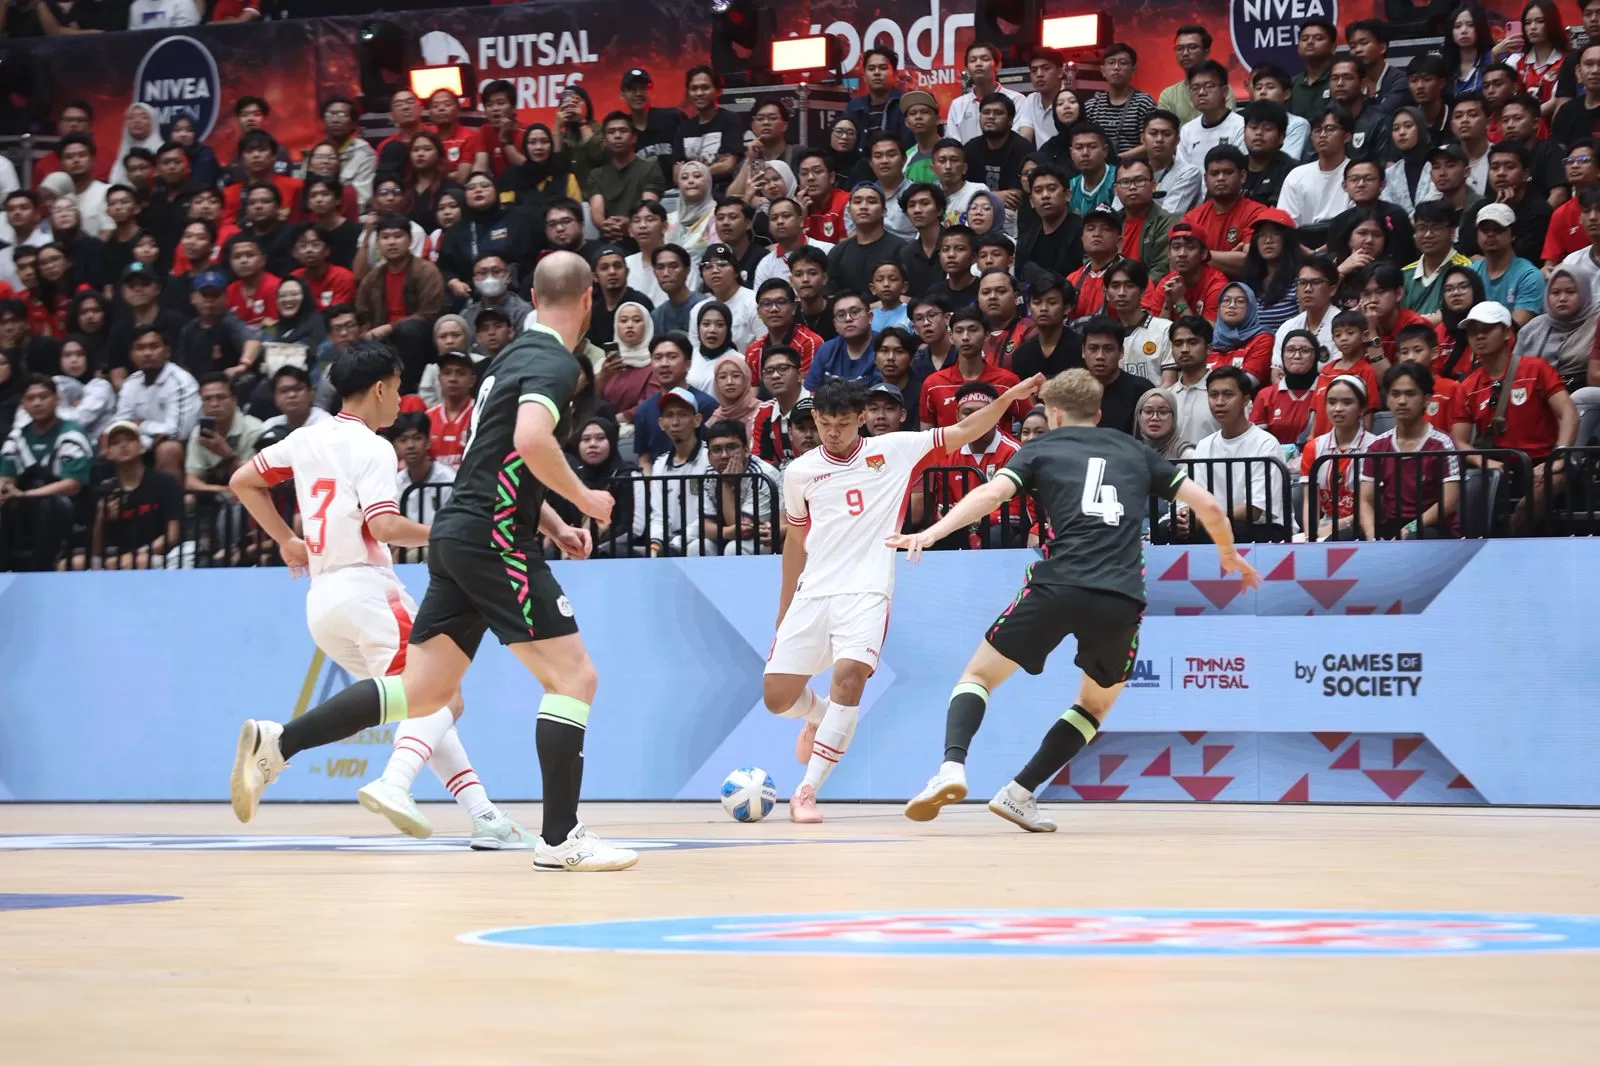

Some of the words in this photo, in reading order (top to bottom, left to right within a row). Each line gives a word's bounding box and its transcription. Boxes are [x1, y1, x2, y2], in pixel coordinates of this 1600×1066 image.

[1243, 0, 1325, 22] NIVEA
[478, 30, 598, 70] FUTSAL
[789, 0, 974, 75] ondr
[144, 77, 210, 101] NIVEA
[845, 489, 864, 516] 9
[1081, 457, 1124, 526] 4
[1185, 657, 1246, 671] TIMNAS
[1295, 661, 1317, 683] by
[1322, 654, 1394, 672] GAMES
[1401, 657, 1418, 668] OF
[1183, 675, 1249, 689] FUTSAL
[1323, 676, 1422, 697] SOCIETY
